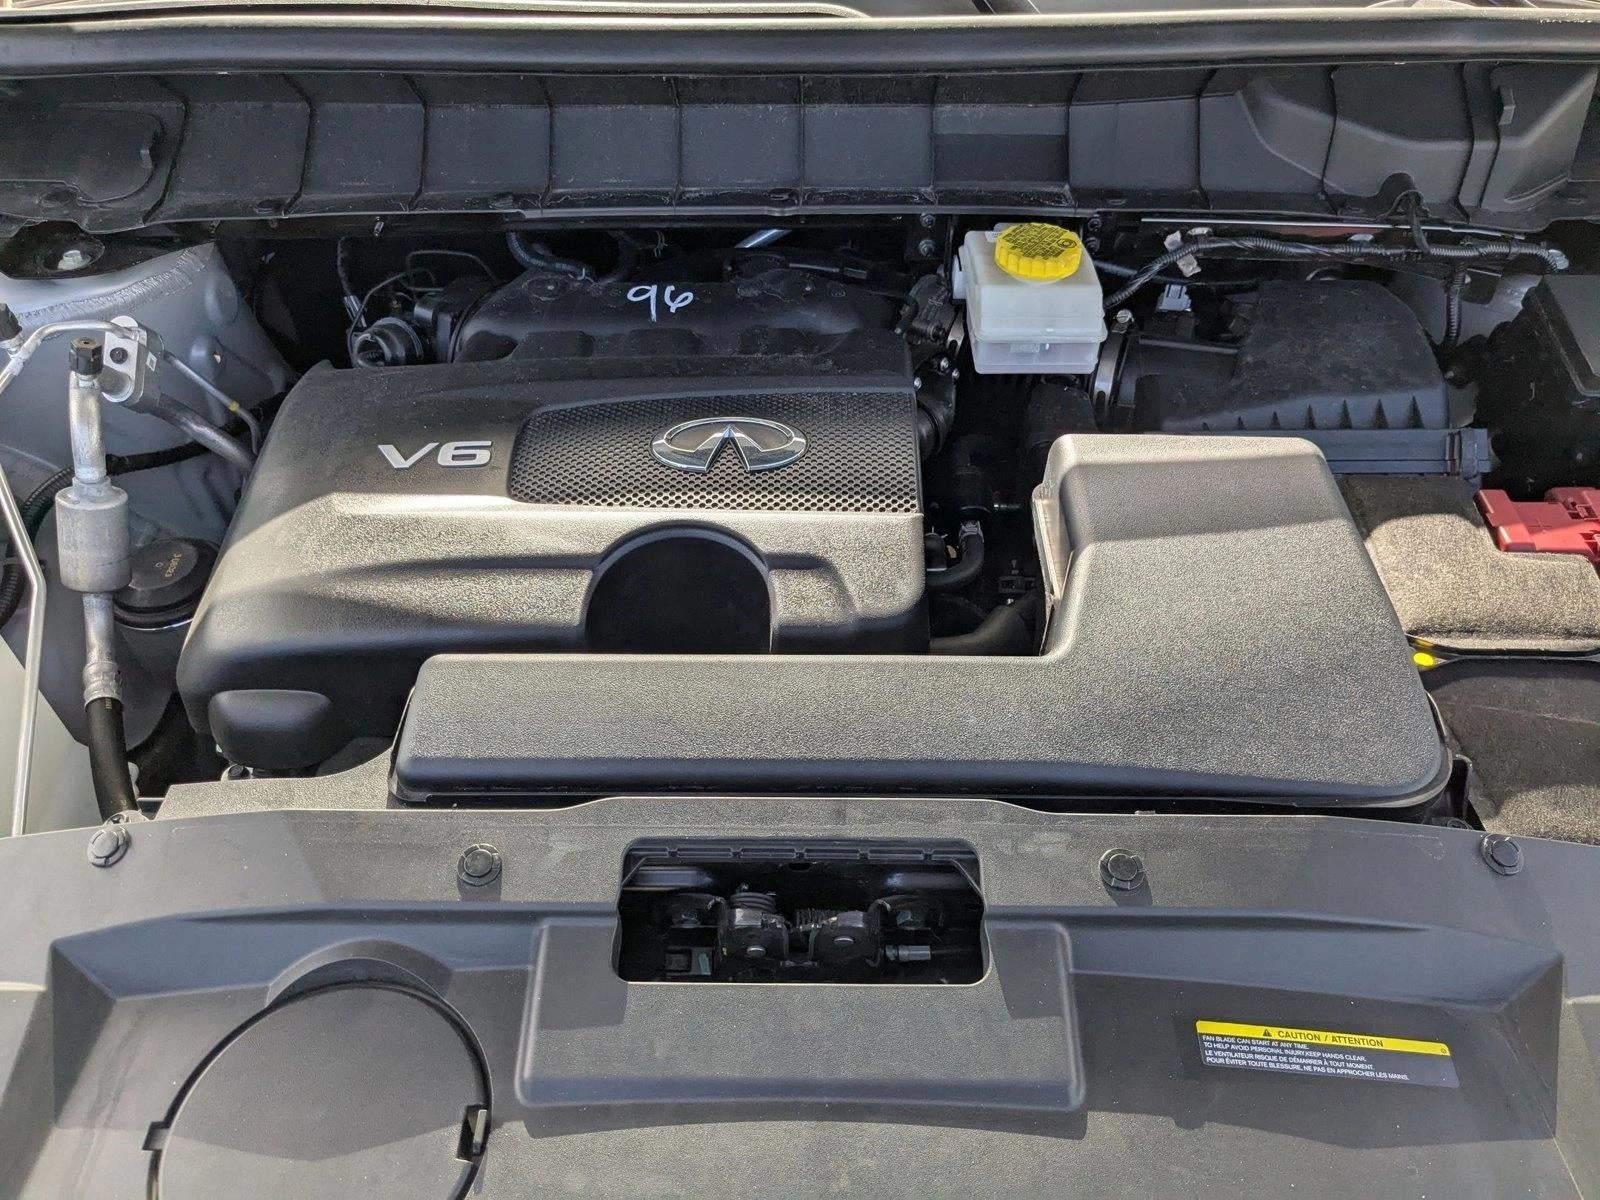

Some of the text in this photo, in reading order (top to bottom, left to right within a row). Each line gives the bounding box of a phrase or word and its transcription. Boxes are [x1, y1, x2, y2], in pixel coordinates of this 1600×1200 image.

[626, 284, 694, 323] 96
[377, 440, 493, 469] V6
[1277, 1030, 1321, 1041] CAUTION
[1331, 1035, 1384, 1048] ATTENTION
[1213, 1051, 1254, 1060] VENTILATEUR
[1254, 1054, 1279, 1062] RISQUE
[1288, 1056, 1323, 1066] DÉMARRER
[1250, 1046, 1283, 1054] PERSONAL
[1322, 1052, 1345, 1060] HANDS
[1344, 1054, 1367, 1062] CLEAR.
[1225, 1057, 1247, 1066] ÉVITER
[1336, 1068, 1376, 1077] APPROCHER
[1387, 1073, 1411, 1081] MAINS.
